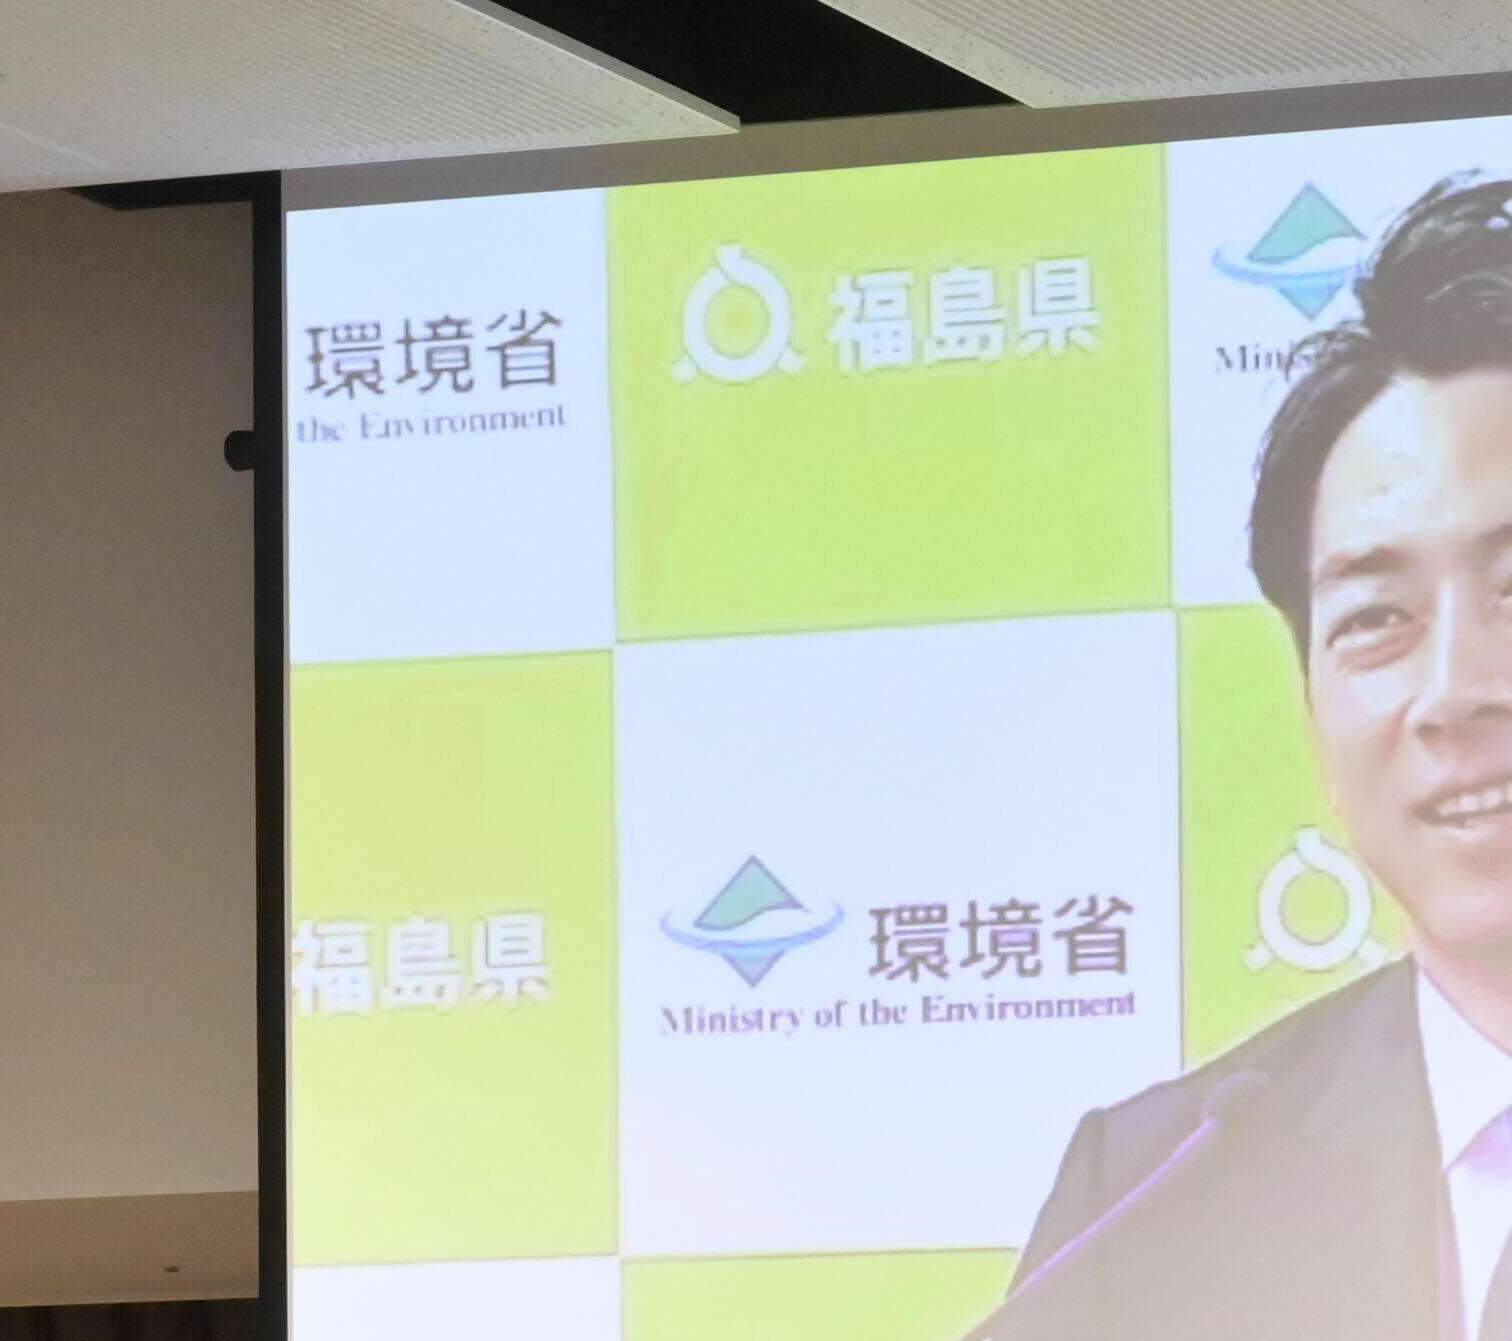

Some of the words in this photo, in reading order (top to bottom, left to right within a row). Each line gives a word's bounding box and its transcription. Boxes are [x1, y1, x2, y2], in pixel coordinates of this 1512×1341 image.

[305, 308, 562, 399] 環境省
[828, 256, 1100, 372] 福島県
[296, 416, 341, 442] the
[360, 404, 566, 439] Environment
[291, 912, 552, 1018] 福島県
[868, 894, 1134, 983] 環境省
[660, 1005, 804, 1037] Ministry
[815, 999, 847, 1028] of
[859, 998, 907, 1026] the
[922, 991, 1136, 1023] Environment
